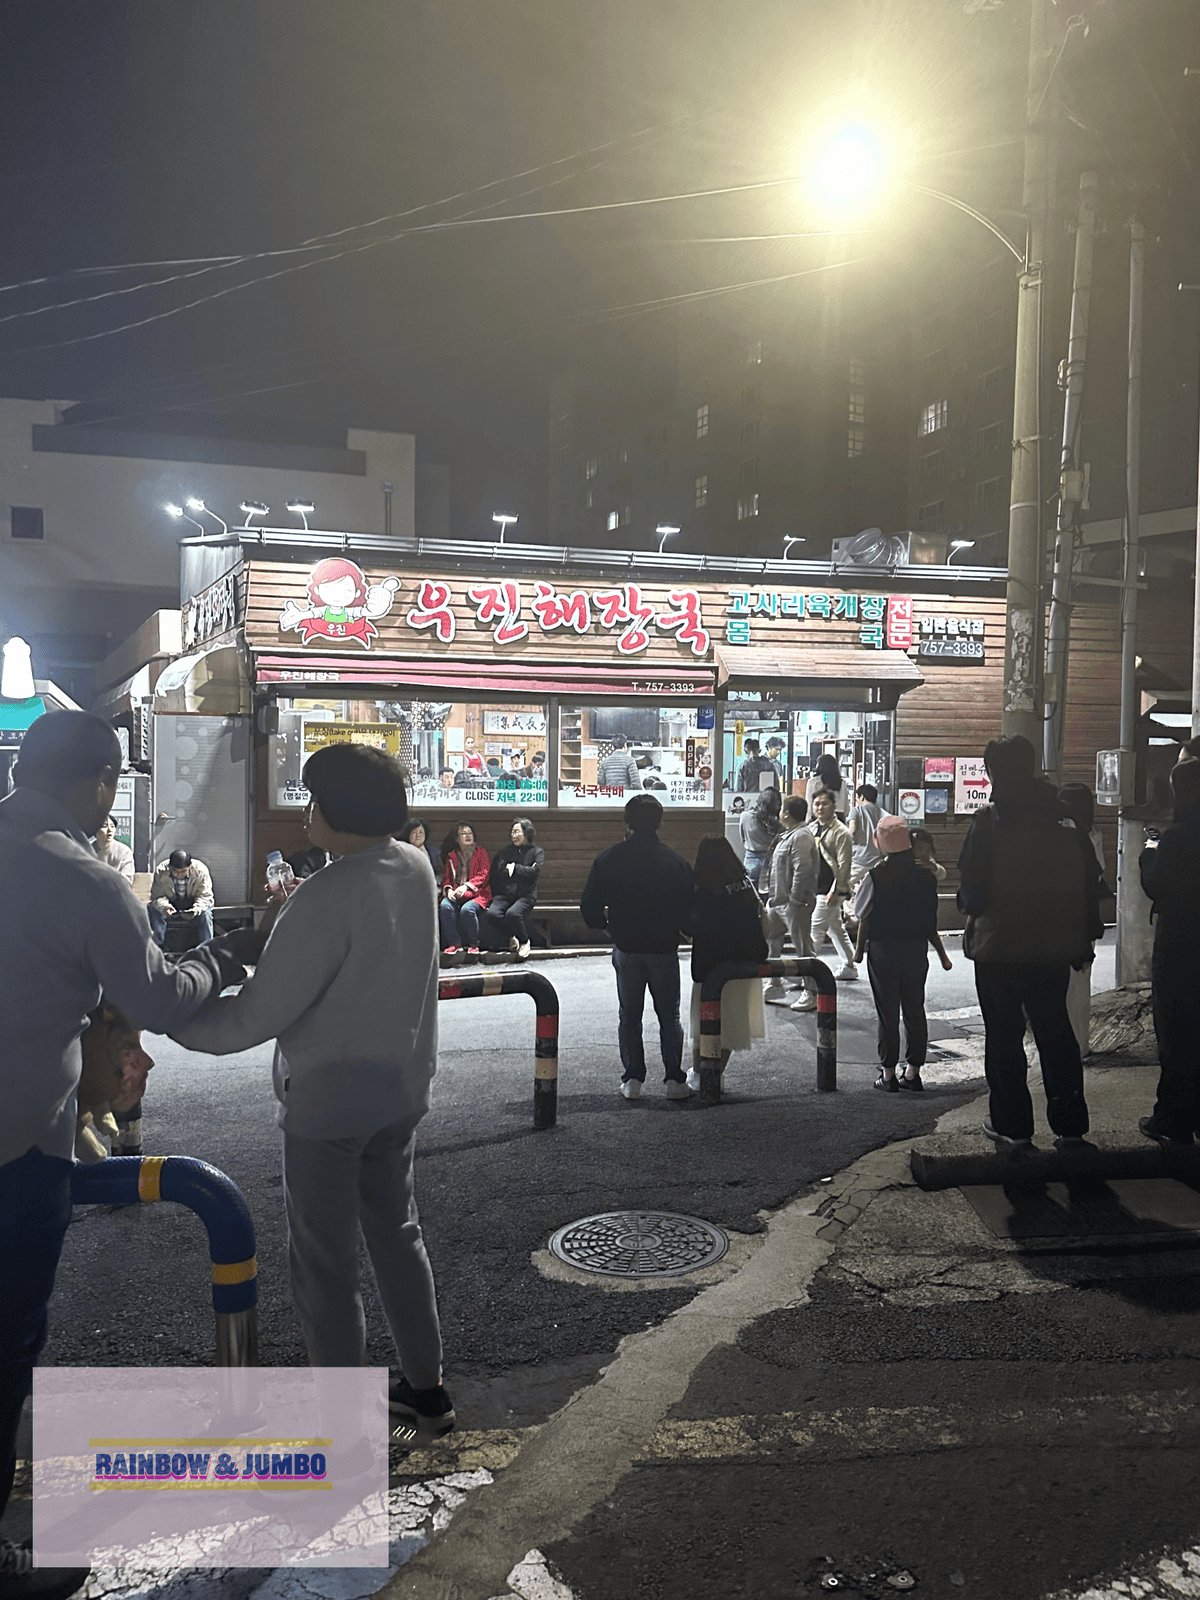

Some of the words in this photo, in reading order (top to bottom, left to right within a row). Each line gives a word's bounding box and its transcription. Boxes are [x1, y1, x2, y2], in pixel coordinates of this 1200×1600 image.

[726, 591, 886, 620] 고사리육개장
[408, 579, 710, 655] 우진해장국
[890, 599, 911, 646] 전문
[327, 623, 346, 636] 우진
[921, 617, 984, 635] 일반음식점
[727, 620, 750, 645] 몸
[860, 624, 884, 650] 국
[922, 641, 983, 655] 757-3393
[279, 671, 340, 681] 우진해장국
[645, 682, 695, 692] 757-3393
[465, 791, 494, 800] CLOSE
[496, 791, 516, 803] 저녁
[520, 792, 548, 802] 22:00
[573, 784, 624, 798] 전국택배
[966, 789, 987, 800] 10m
